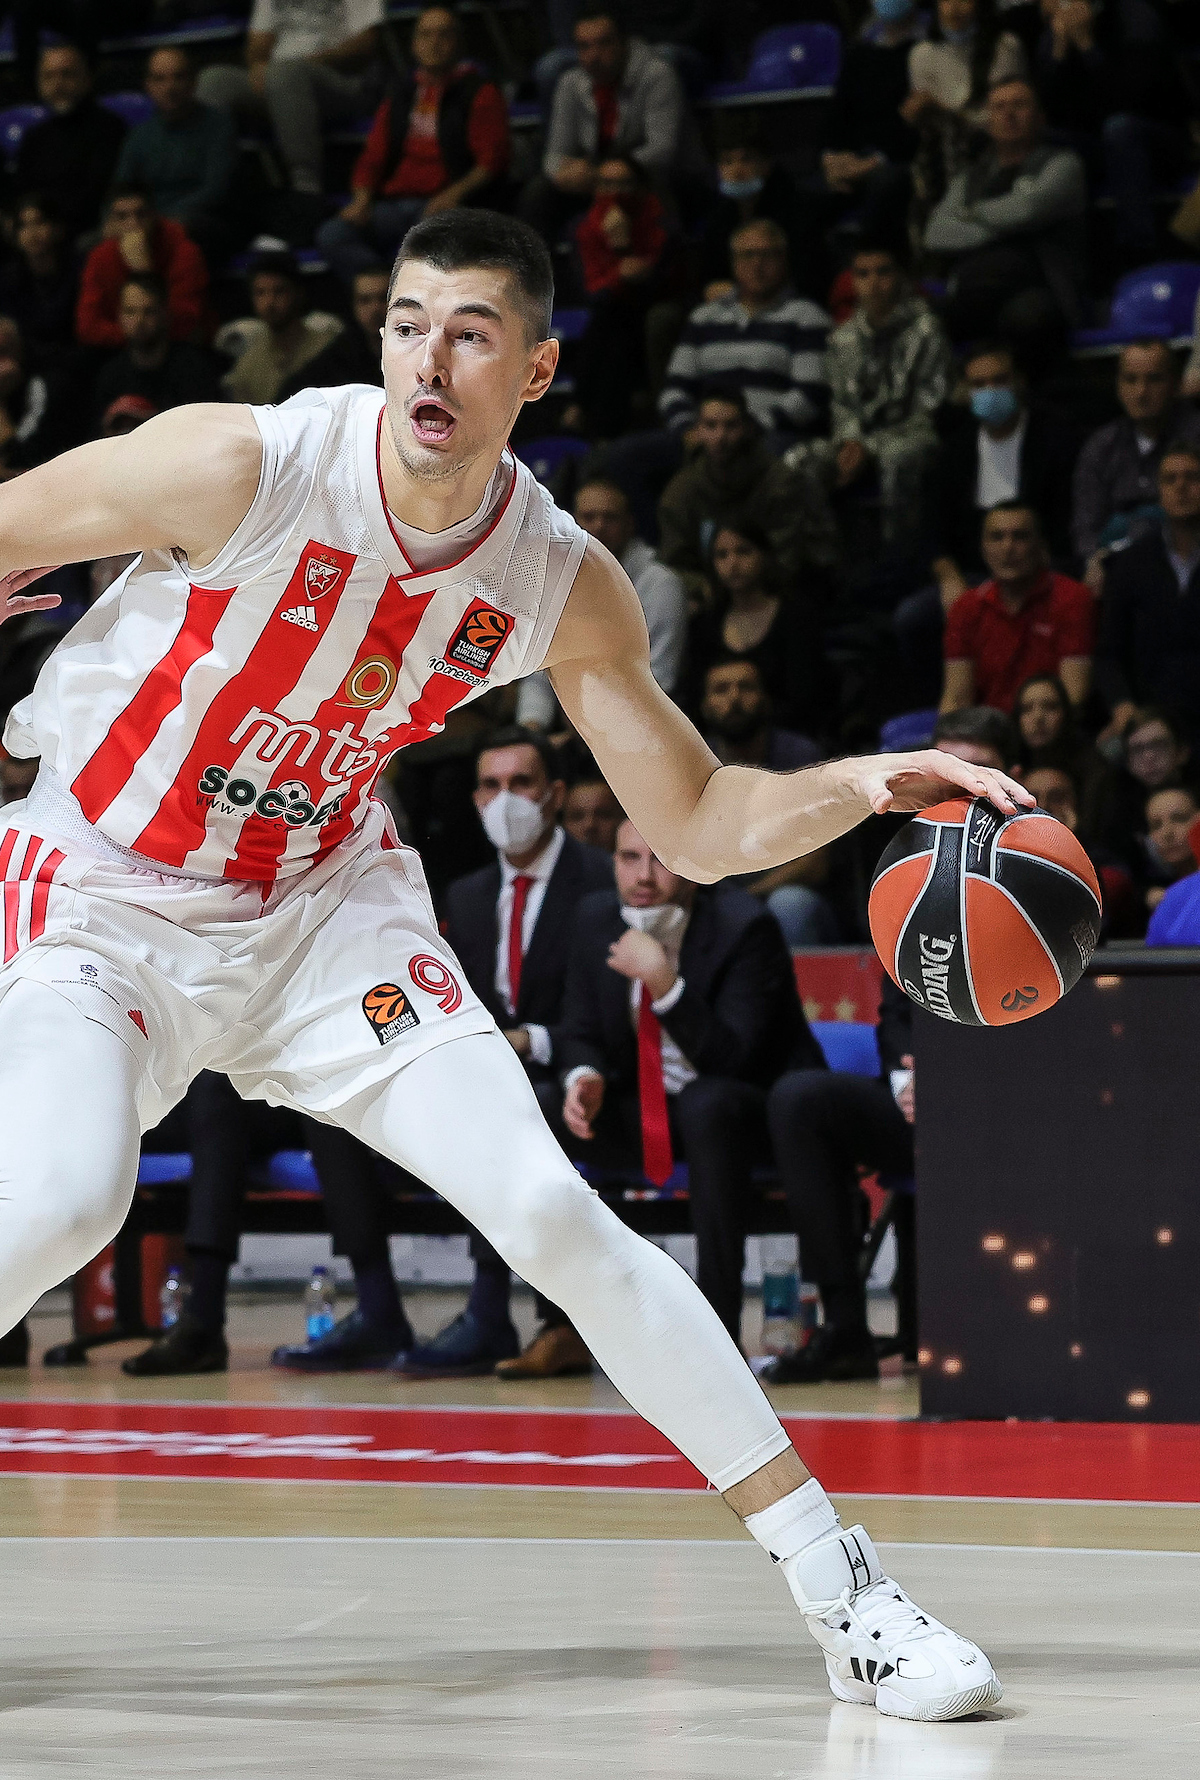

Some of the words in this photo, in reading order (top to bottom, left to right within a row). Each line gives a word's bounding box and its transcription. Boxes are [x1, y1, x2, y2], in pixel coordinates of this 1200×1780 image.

[280, 611, 319, 632] adidas
[454, 646, 488, 664] AIRLINES
[458, 639, 491, 659] TURKISH
[335, 654, 397, 710] 9
[407, 953, 463, 1015] 9
[919, 932, 962, 1023] ALDING
